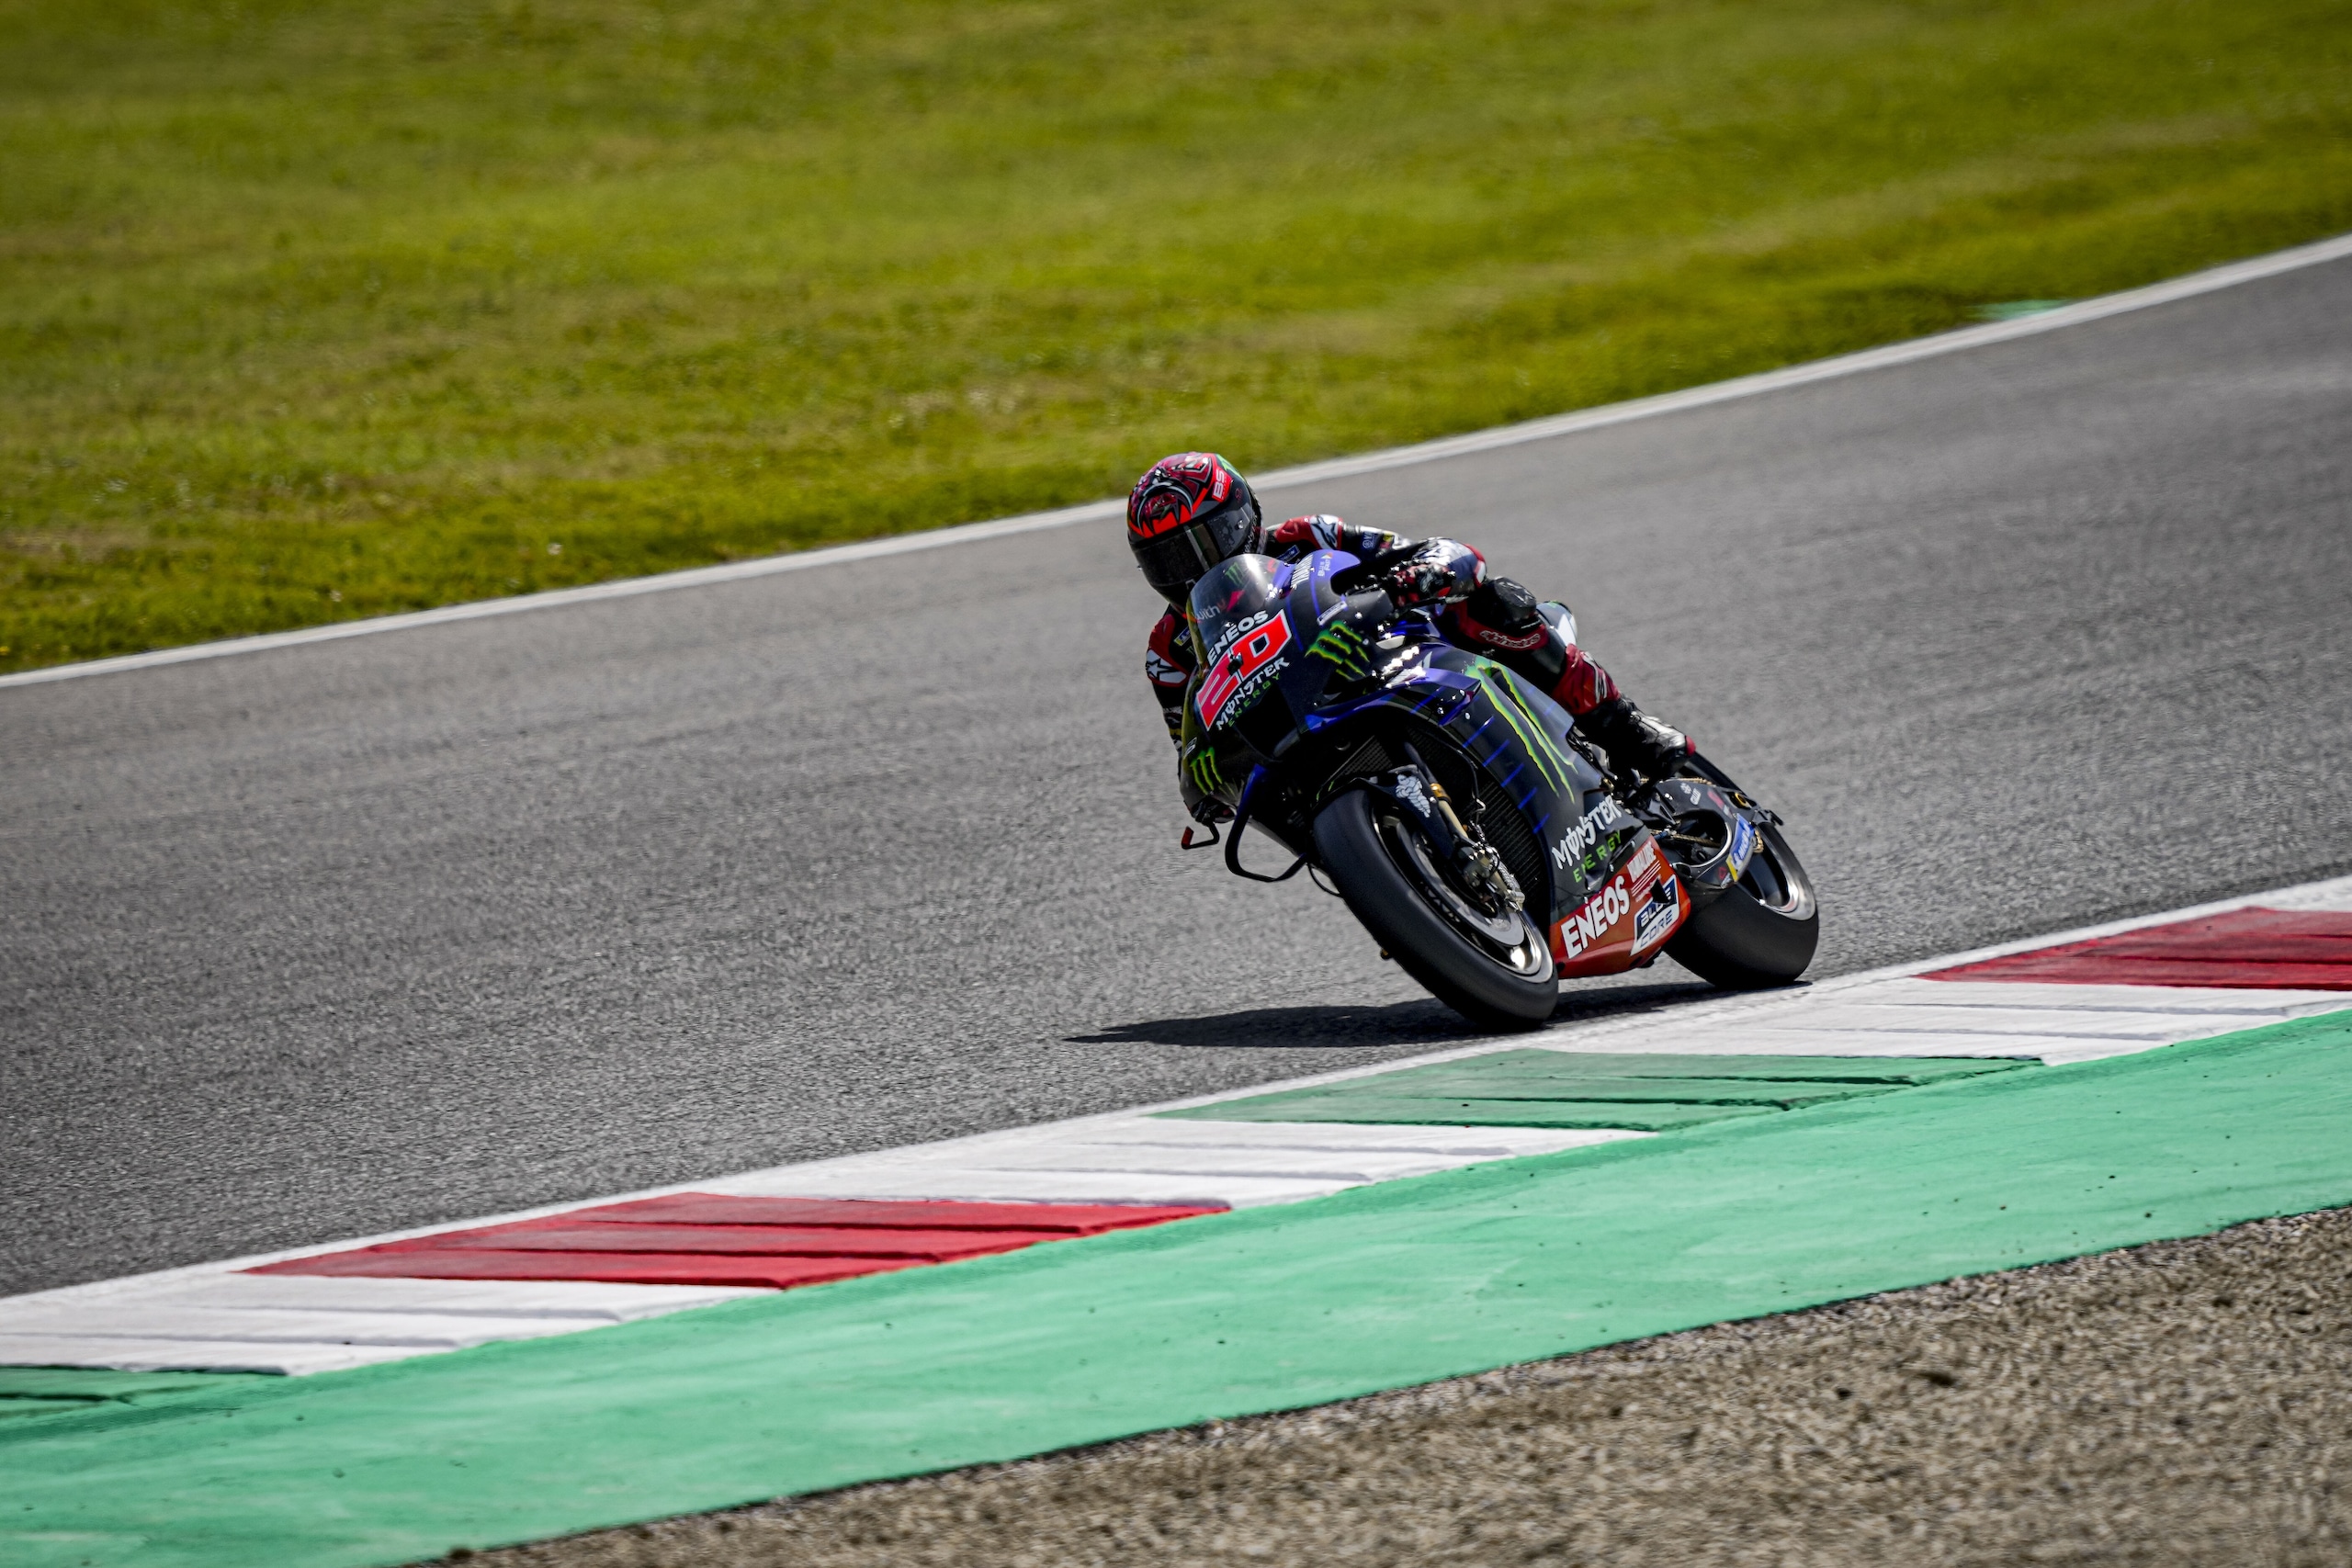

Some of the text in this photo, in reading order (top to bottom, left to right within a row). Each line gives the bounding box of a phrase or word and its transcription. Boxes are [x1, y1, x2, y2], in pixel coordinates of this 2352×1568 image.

[1207, 610, 1269, 666] ENEOS
[1216, 657, 1290, 731] MONSTER
[1228, 672, 1281, 728] ENERGY
[1551, 795, 1623, 870] MONSTER
[1560, 875, 1630, 959] ENEOS
[1640, 909, 1673, 948] CORE
